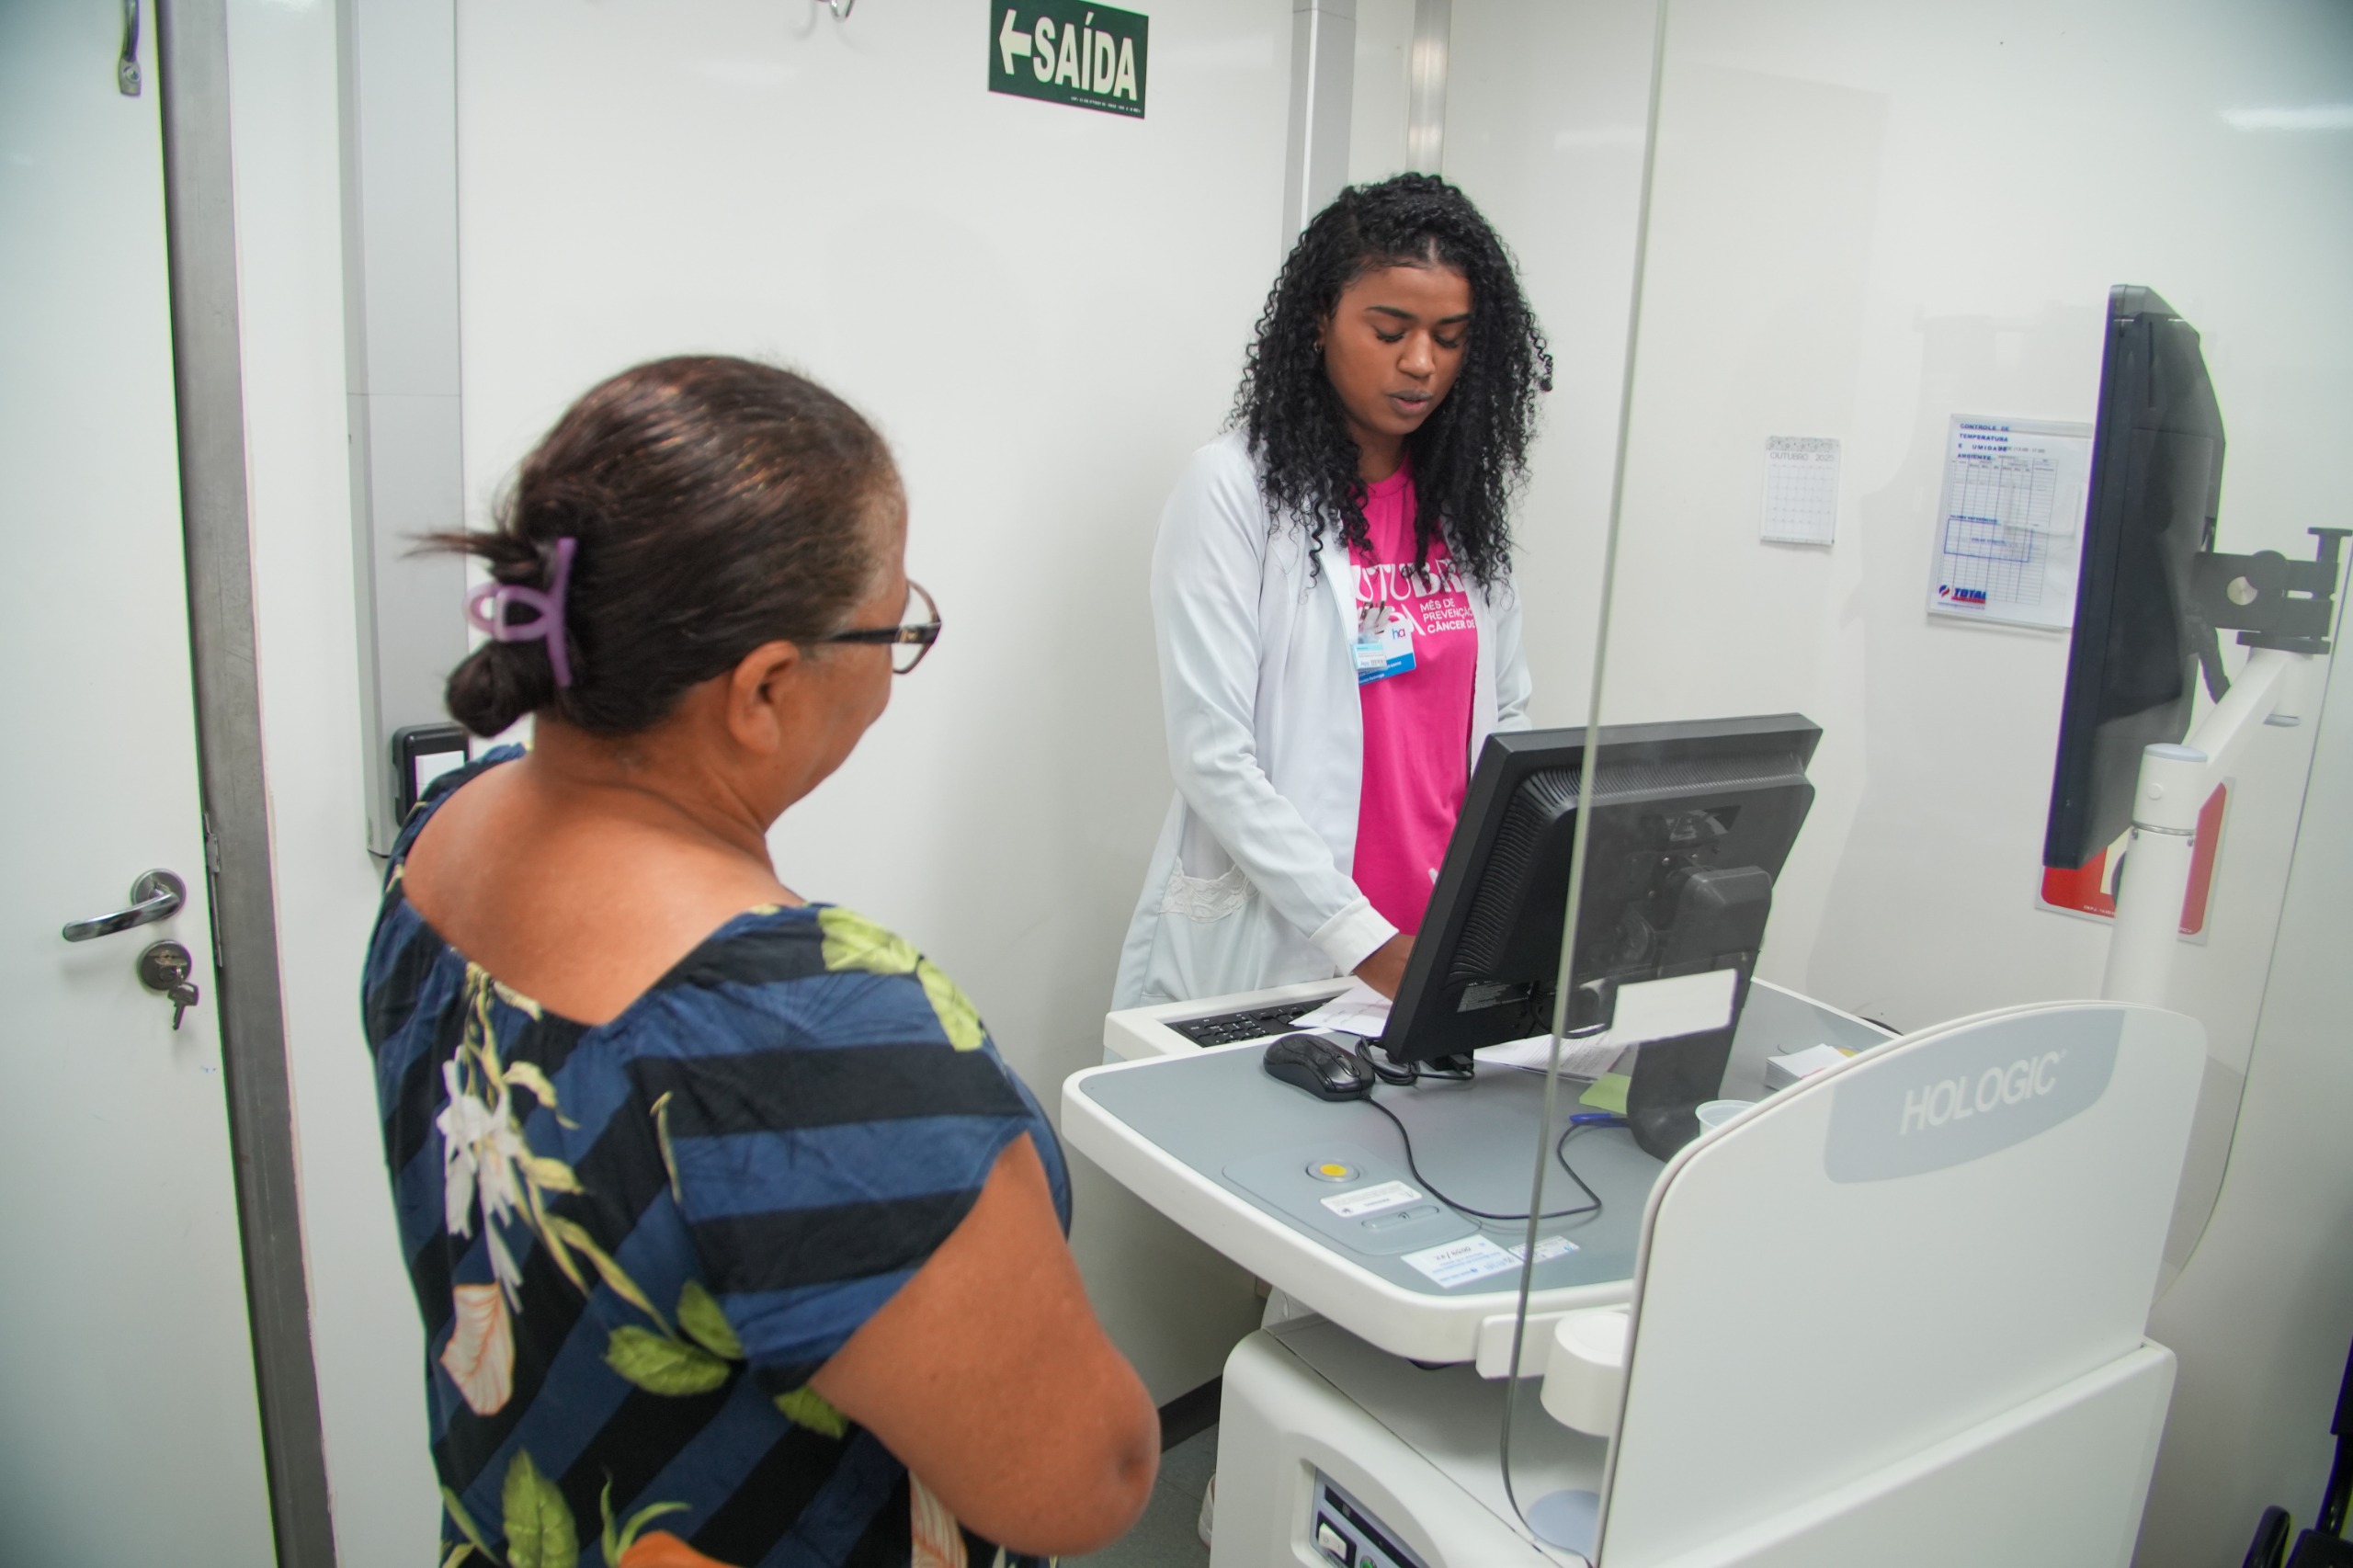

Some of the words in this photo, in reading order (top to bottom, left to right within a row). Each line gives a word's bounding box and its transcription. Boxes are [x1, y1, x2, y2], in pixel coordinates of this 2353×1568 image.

[1032, 11, 1138, 101] SAÍDA
[1960, 423, 1996, 431] CONTROLE
[1959, 433, 2008, 442] TEMPERATURA
[1770, 451, 1808, 460] OUTUBRO
[1419, 599, 1442, 613] MÊS
[1443, 597, 1455, 608] DE
[1427, 619, 1466, 633] CÂNCER
[1392, 628, 1406, 639] ha
[1899, 1051, 2060, 1135] HOLOGIC
